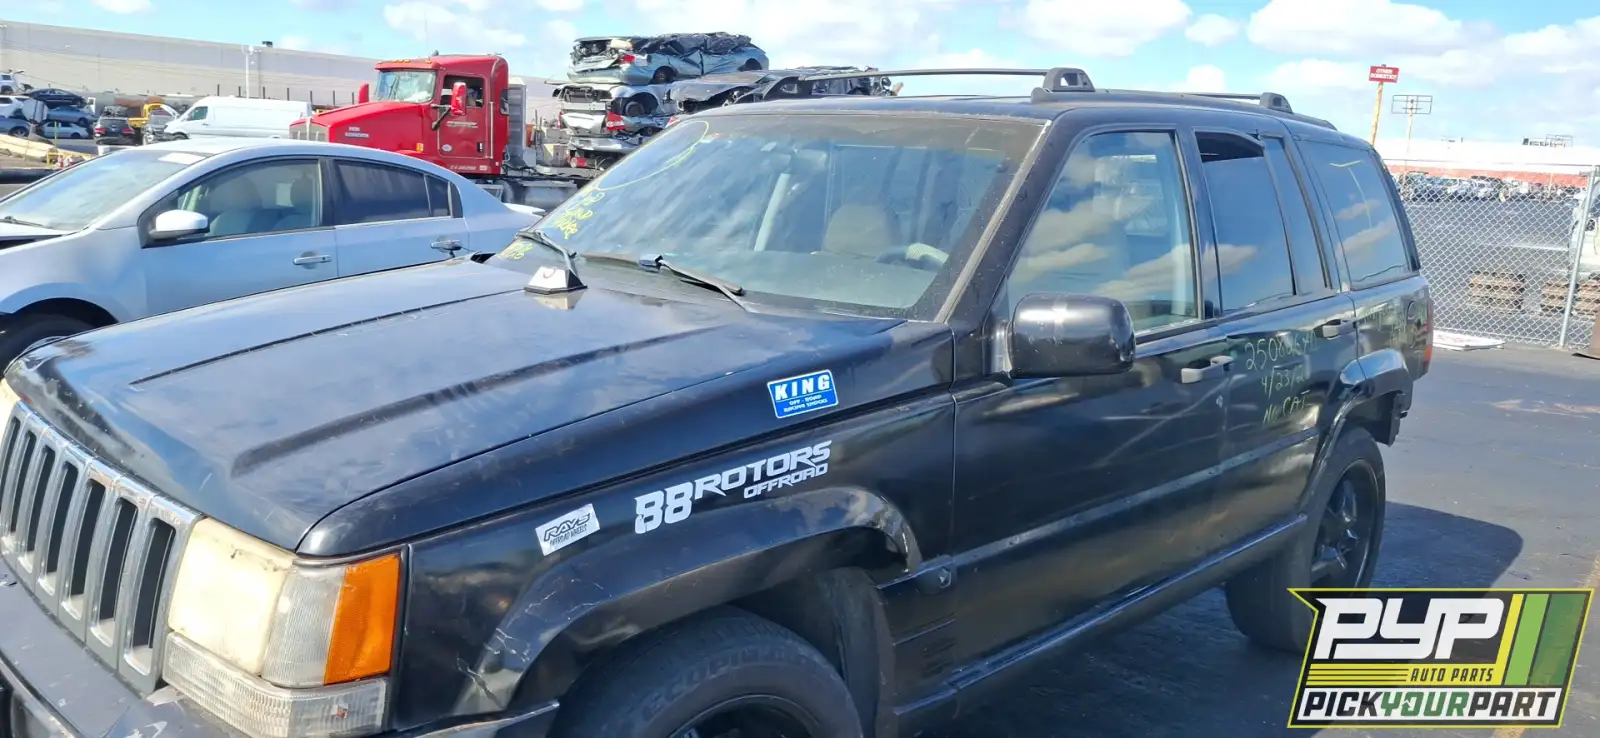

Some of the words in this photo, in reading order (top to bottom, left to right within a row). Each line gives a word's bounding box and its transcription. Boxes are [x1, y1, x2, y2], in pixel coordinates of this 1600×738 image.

[775, 374, 830, 401] KING
[634, 481, 693, 535] 88
[694, 440, 833, 500] ROTORS
[743, 463, 829, 499] OFFROAD
[543, 512, 591, 542] RAYS
